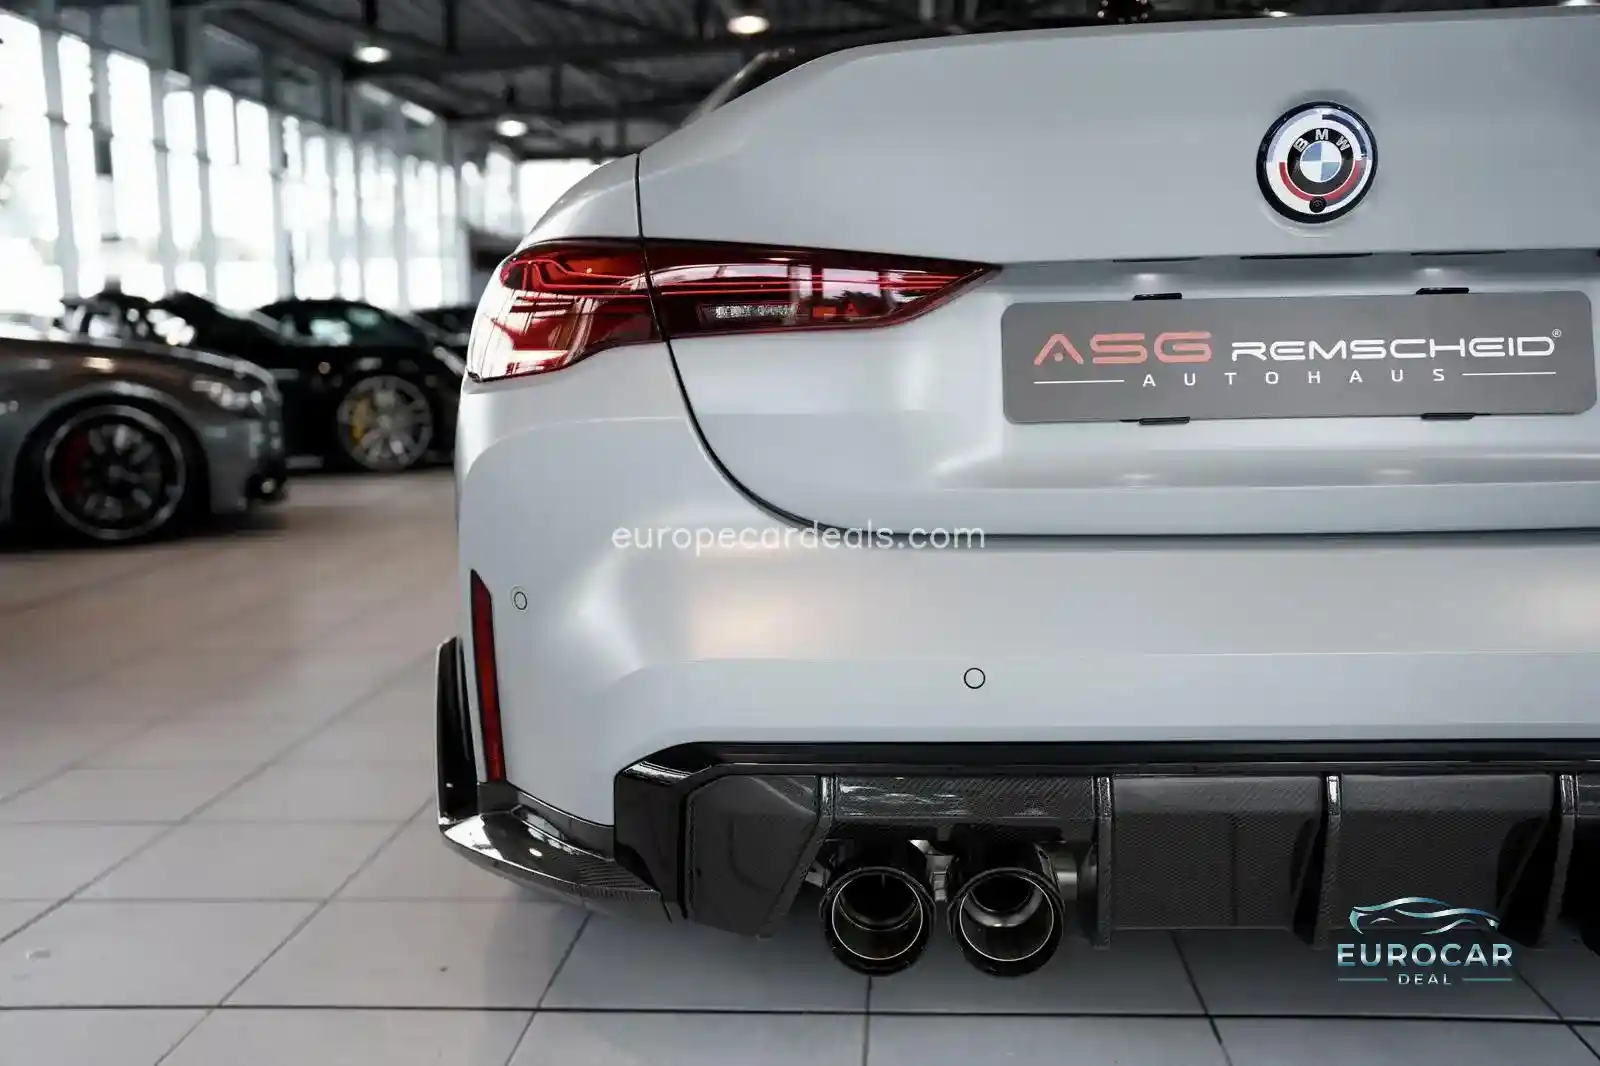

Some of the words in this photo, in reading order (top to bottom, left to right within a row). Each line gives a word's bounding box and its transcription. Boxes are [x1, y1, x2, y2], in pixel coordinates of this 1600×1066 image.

[1293, 128, 1350, 152] BMW
[1033, 331, 1213, 366] ASG
[1142, 368, 1446, 388] AUTOHAUS
